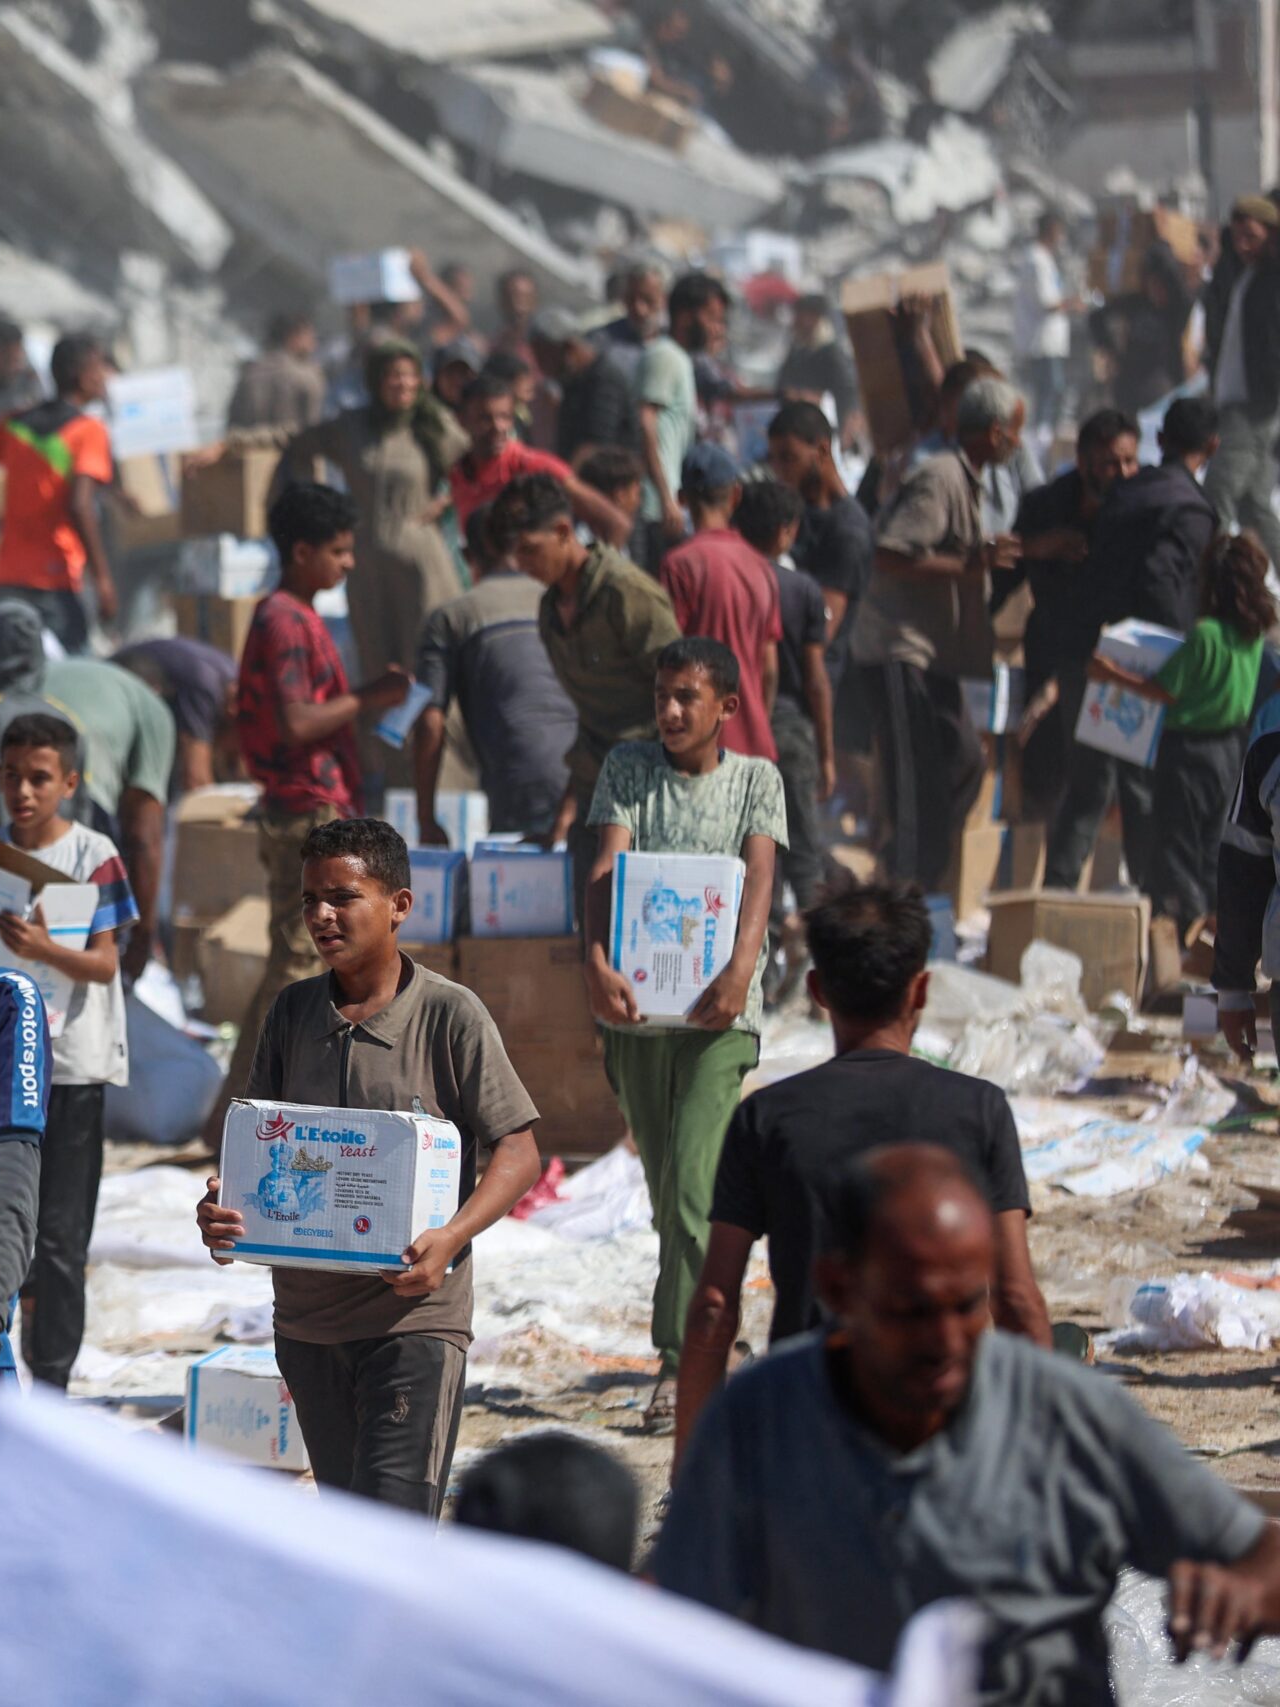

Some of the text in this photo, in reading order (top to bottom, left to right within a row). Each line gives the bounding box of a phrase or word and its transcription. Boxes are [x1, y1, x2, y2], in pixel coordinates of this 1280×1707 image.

[18, 987, 39, 1108] Motorsport
[295, 1125, 367, 1145] L'Etoile
[339, 1144, 379, 1158] Yeast
[267, 1208, 300, 1221] L'Etoile
